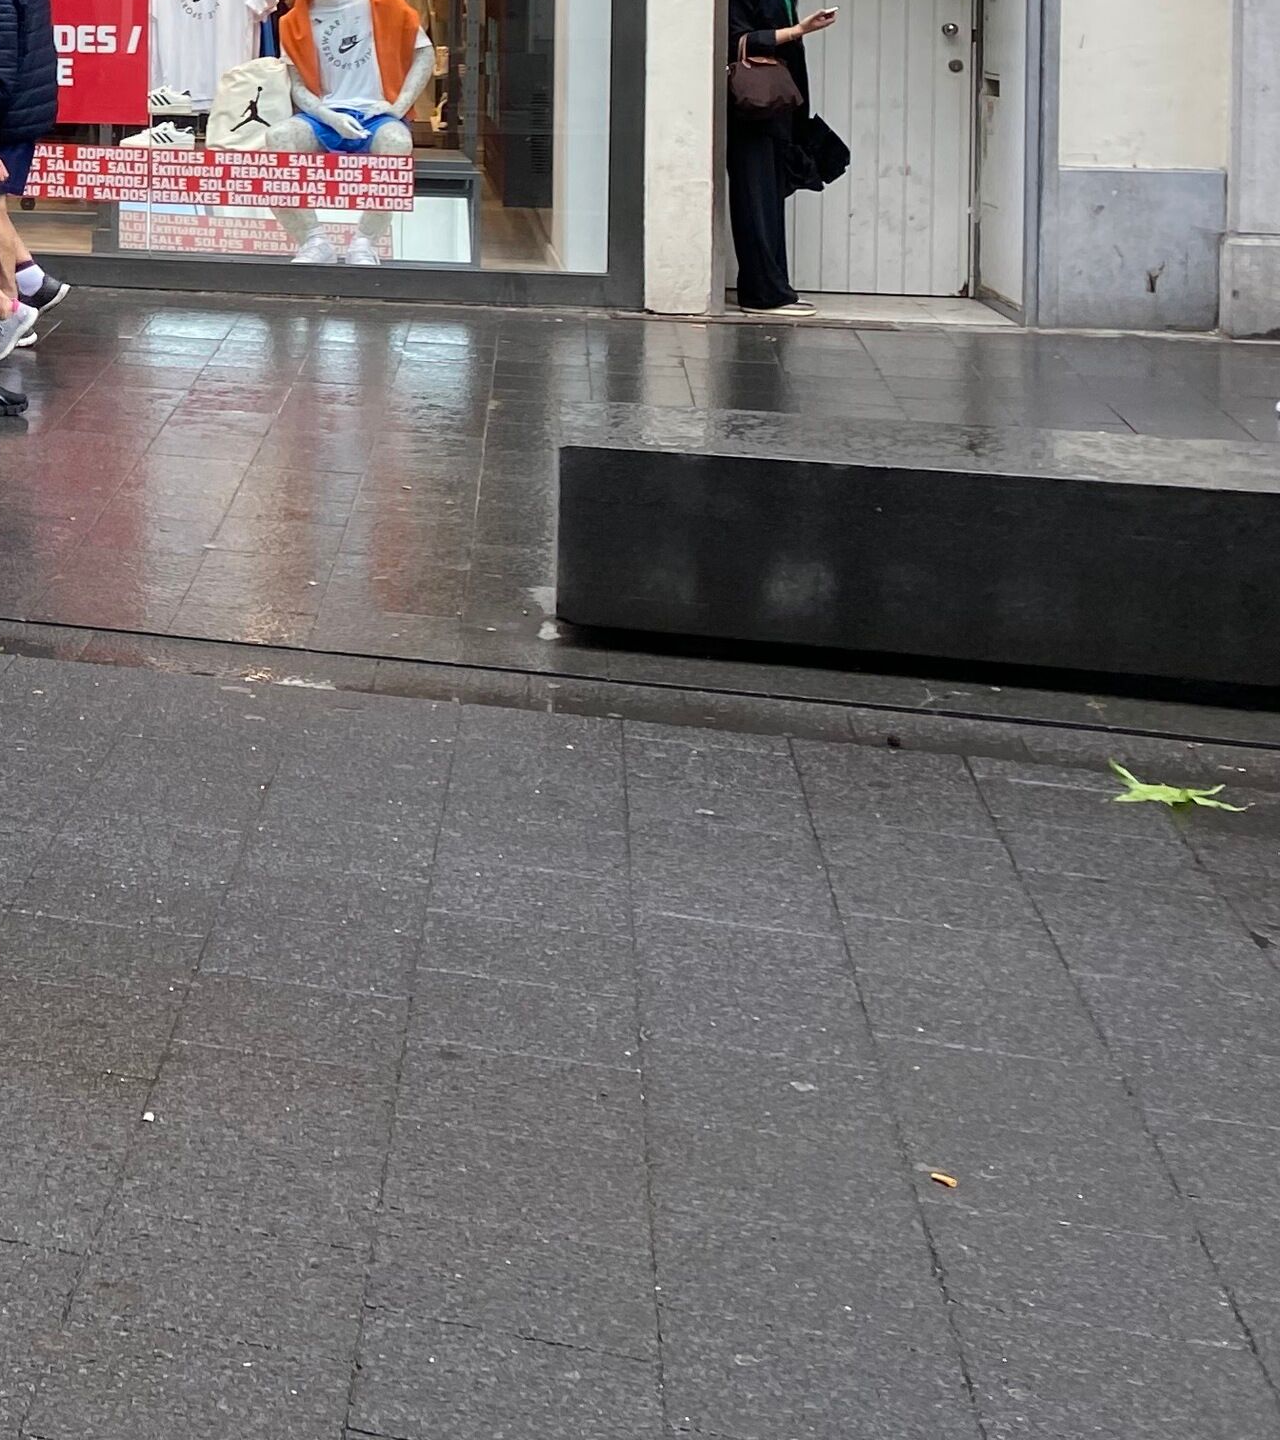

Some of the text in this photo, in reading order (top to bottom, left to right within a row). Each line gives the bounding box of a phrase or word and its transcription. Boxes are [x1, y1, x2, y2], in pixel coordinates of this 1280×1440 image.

[77, 147, 148, 162] DOPRODEJ
[152, 151, 204, 165] SOLDES
[215, 153, 278, 166] REBAJAS
[289, 154, 325, 167] SALE
[339, 156, 413, 170] DOPRODEJ
[46, 159, 100, 172] SALDOS
[108, 162, 148, 175] SALDI
[230, 166, 300, 180] REBAIXES
[306, 169, 363, 182] SALDOS
[370, 170, 413, 183] SALDI
[77, 174, 148, 188] DOPRODEJ
[152, 176, 187, 189] SALE
[200, 178, 252, 192] SOLDES
[262, 181, 326, 194] REBAJAS
[339, 183, 413, 197] DOPRODEJ
[47, 185, 87, 198] SALDI
[93, 187, 147, 201] SALDOS
[152, 191, 221, 205] REBAIXES
[307, 195, 349, 209] SALDI
[356, 197, 413, 211] SALDOS
[151, 235, 183, 246] SALE
